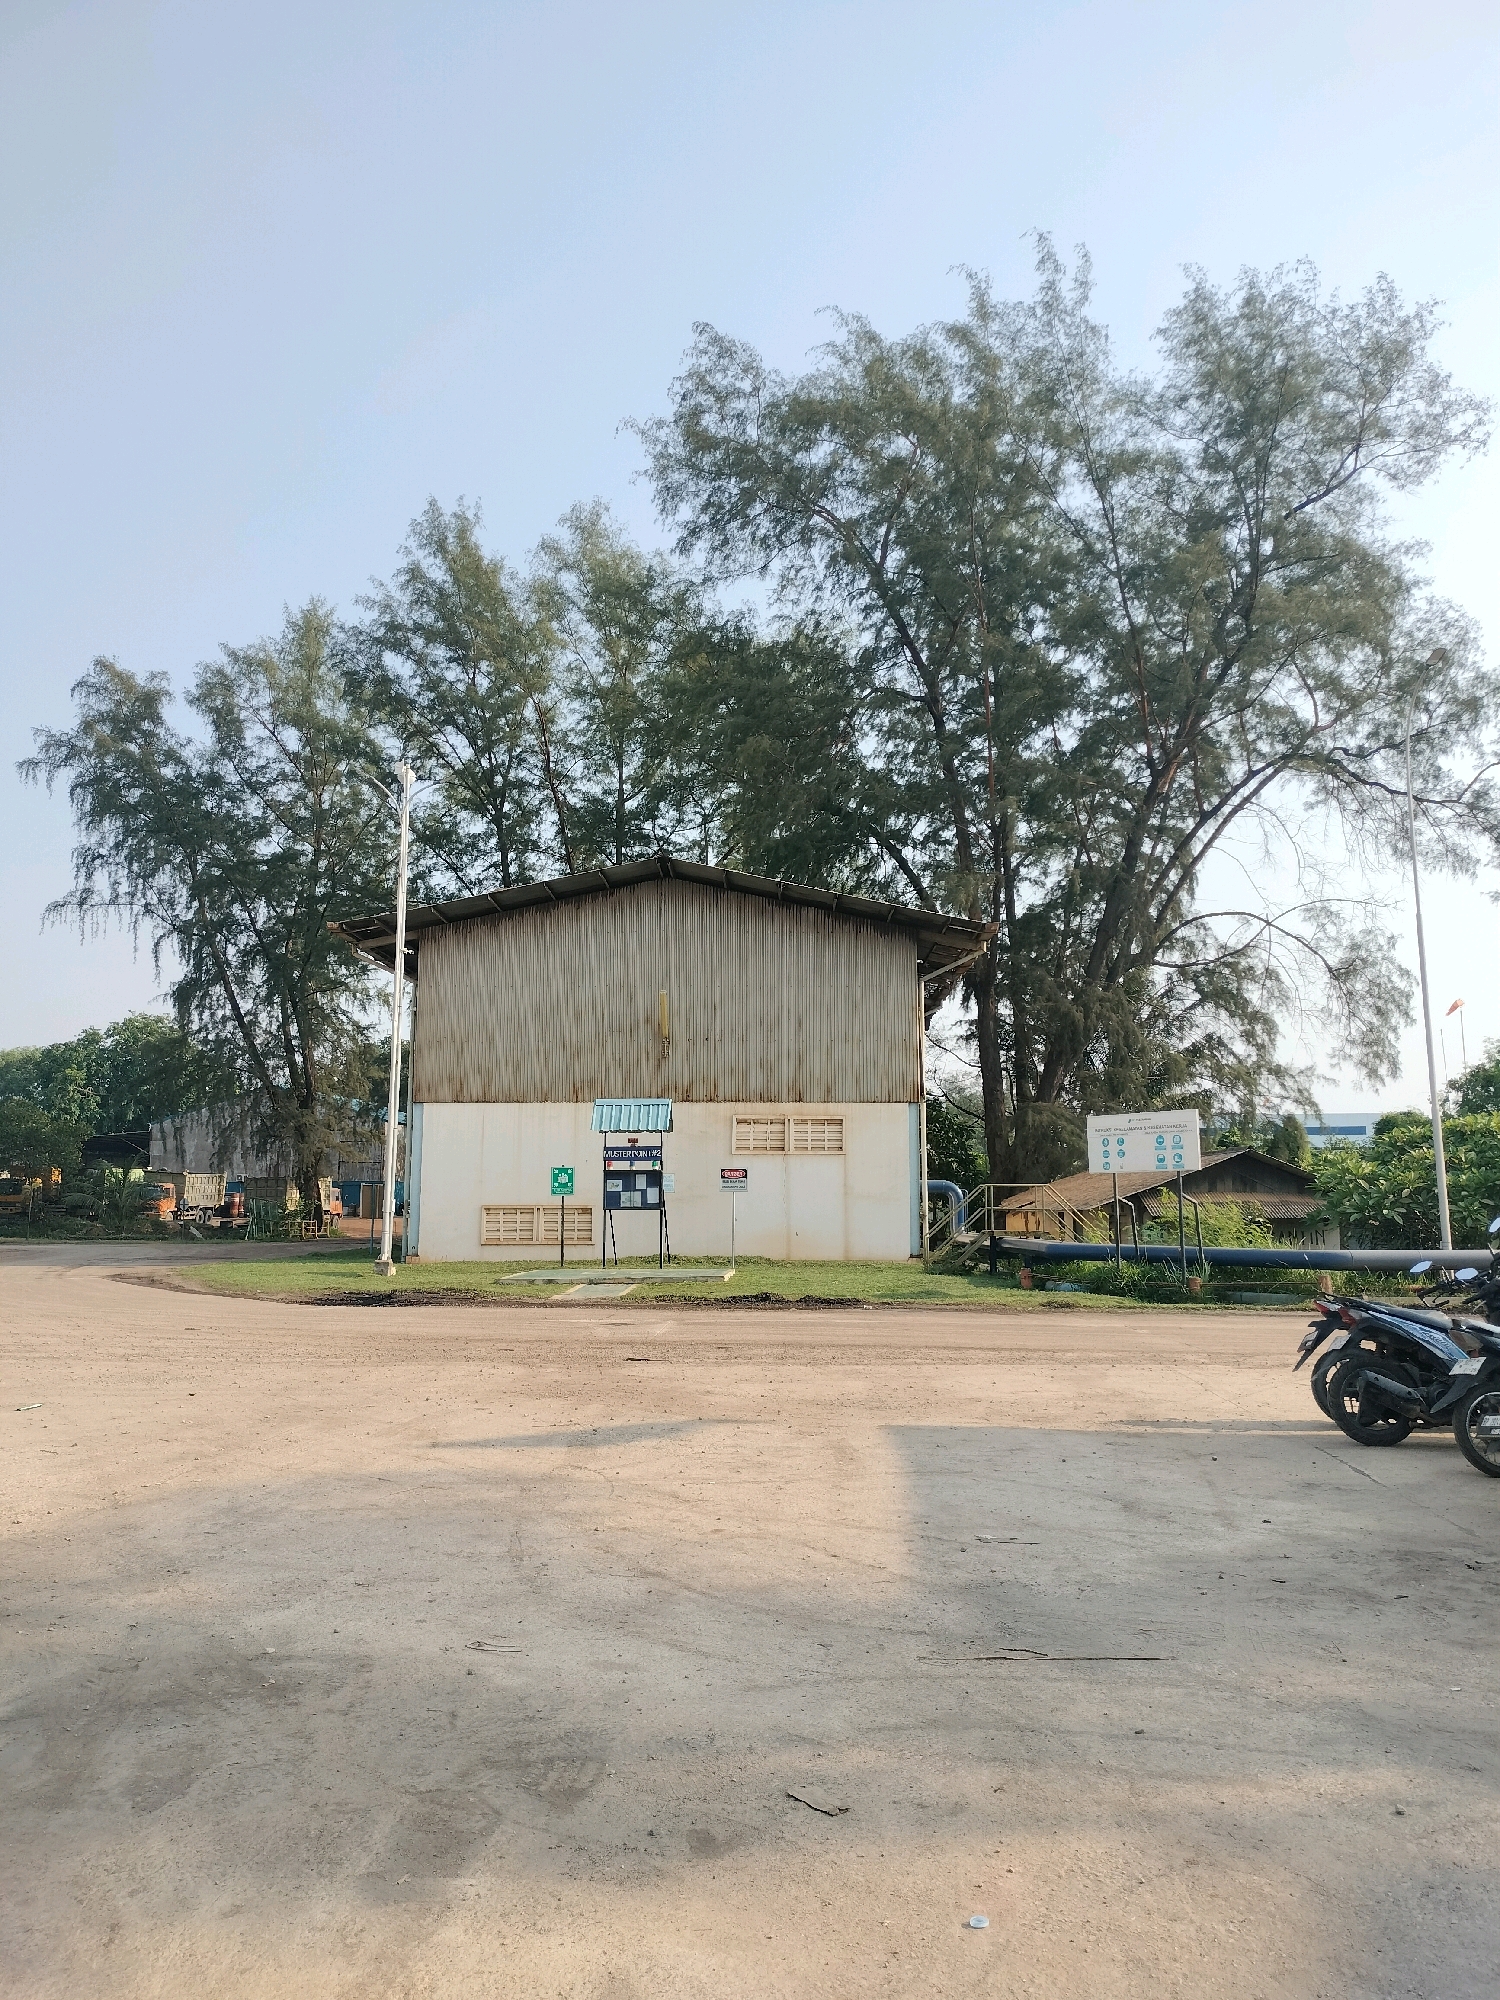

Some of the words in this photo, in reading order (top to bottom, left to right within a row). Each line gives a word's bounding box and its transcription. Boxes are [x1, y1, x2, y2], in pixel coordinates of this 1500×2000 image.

[604, 1150, 631, 1158] MUSTER
[652, 1149, 661, 1157] #2
[1278, 1228, 1326, 1246] ANTIN
